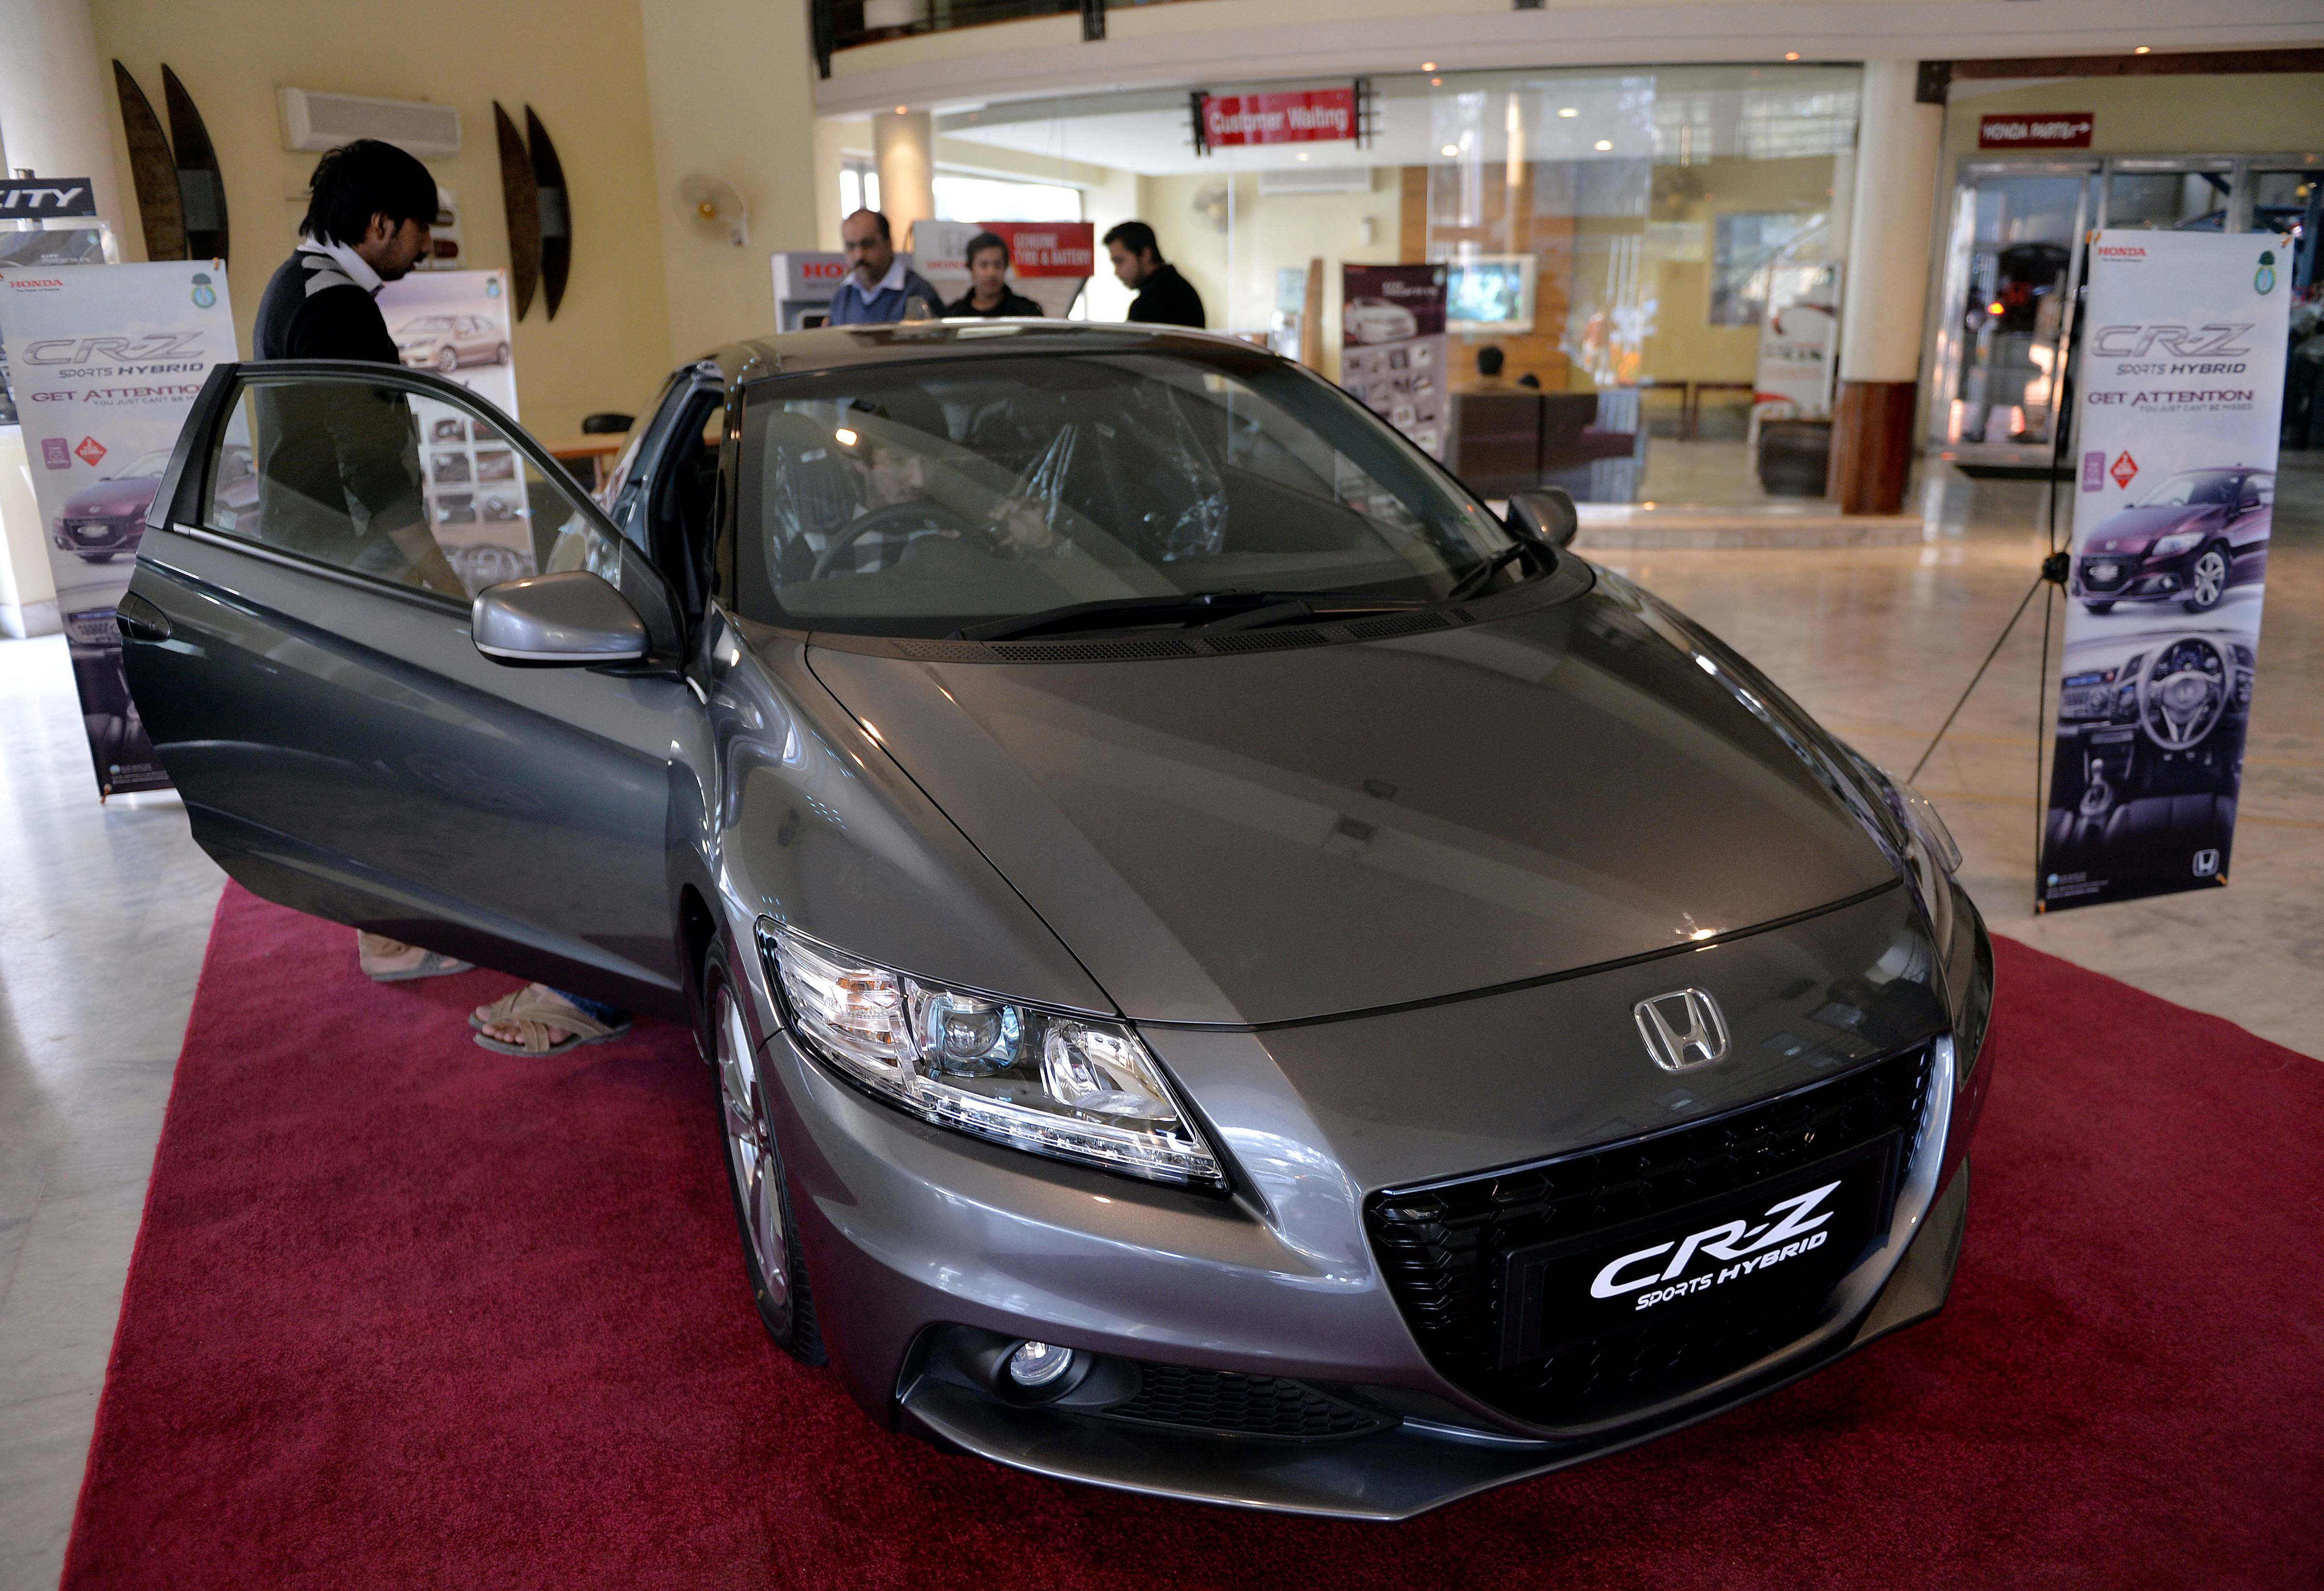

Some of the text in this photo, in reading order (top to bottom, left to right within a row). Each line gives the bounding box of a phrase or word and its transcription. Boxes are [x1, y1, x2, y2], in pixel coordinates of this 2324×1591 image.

[1287, 105, 1348, 131] Waiting
[2098, 247, 2146, 256] HONDA
[10, 279, 64, 288] HONDA
[22, 331, 205, 365] CR-Z
[2091, 323, 2256, 358] CR-Z
[59, 363, 204, 379] SPORTS HYBRID
[2116, 363, 2246, 375] SPORTS HYBRID
[31, 383, 203, 402] GET ATTENTIO
[2088, 390, 2254, 406] GET ATTENTION
[1590, 1180, 1841, 1299] CR-Z
[1635, 1231, 1828, 1311] SPORTS HYBRID
